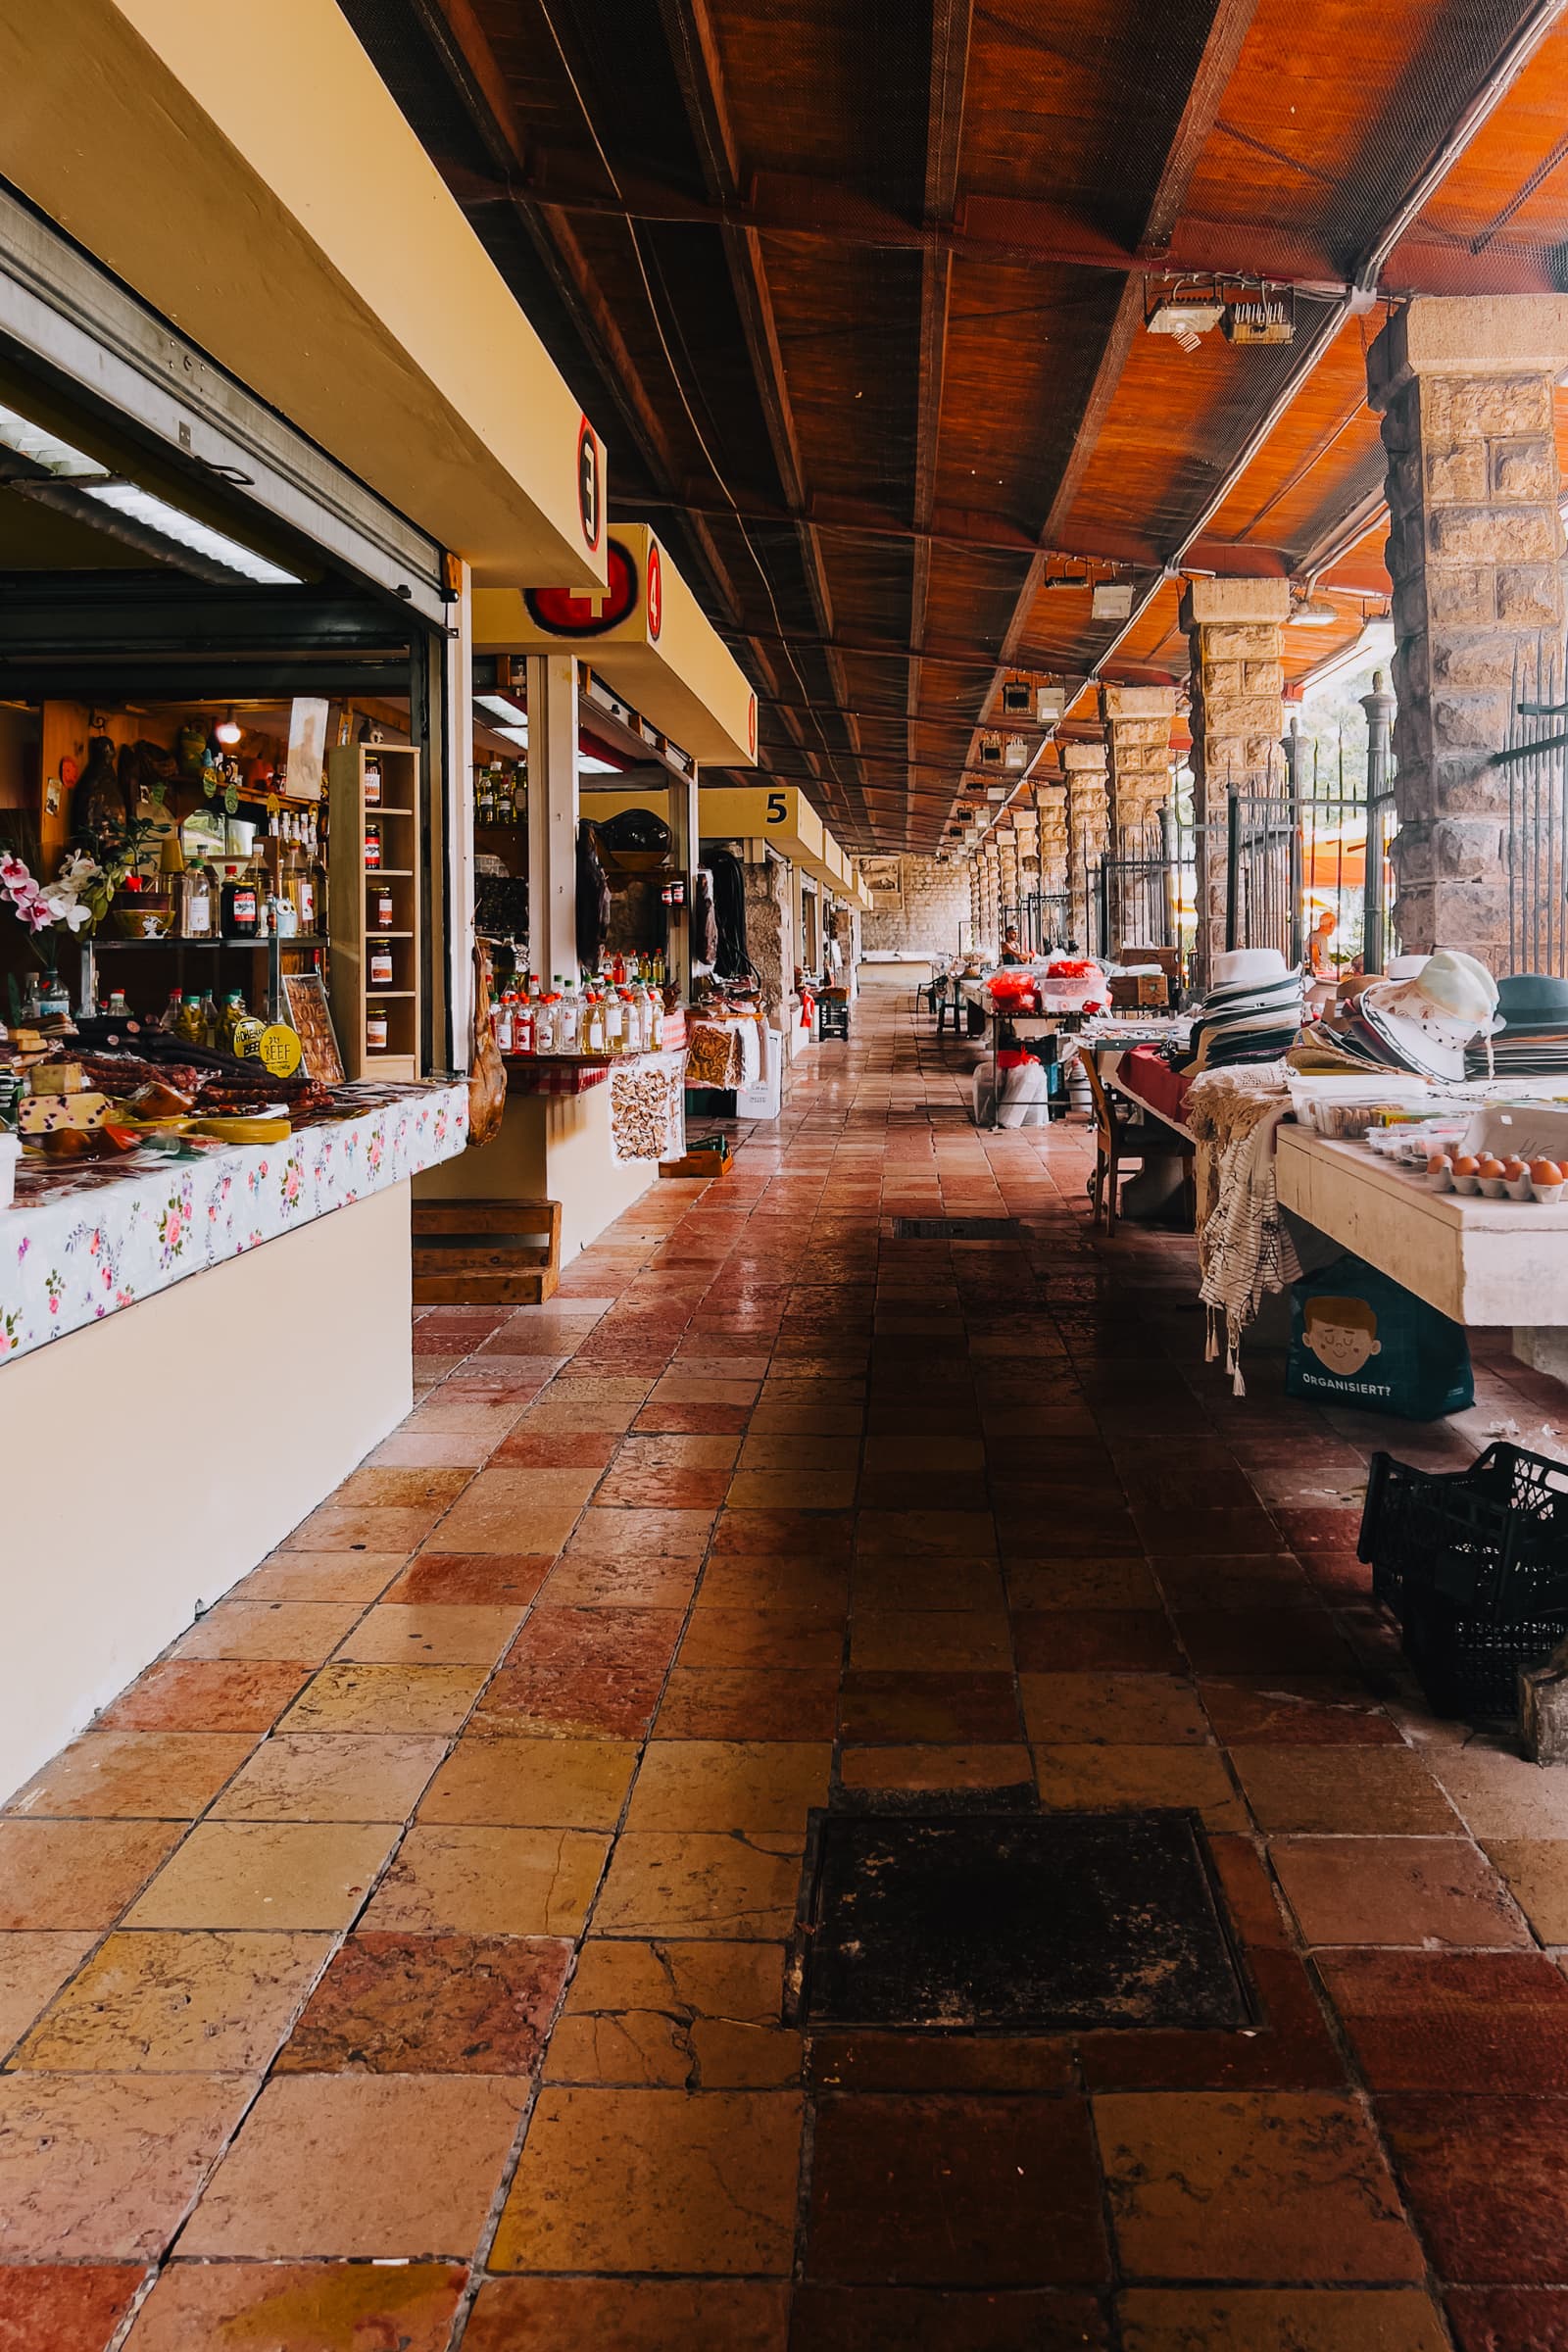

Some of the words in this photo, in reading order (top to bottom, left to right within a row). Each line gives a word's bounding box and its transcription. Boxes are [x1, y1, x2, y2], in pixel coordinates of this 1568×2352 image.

[584, 442, 596, 543] 3
[650, 566, 659, 627] 4
[766, 793, 787, 824] 5
[264, 1044, 291, 1061] BEEF
[1302, 1373, 1391, 1397] ORGANISIERT?
